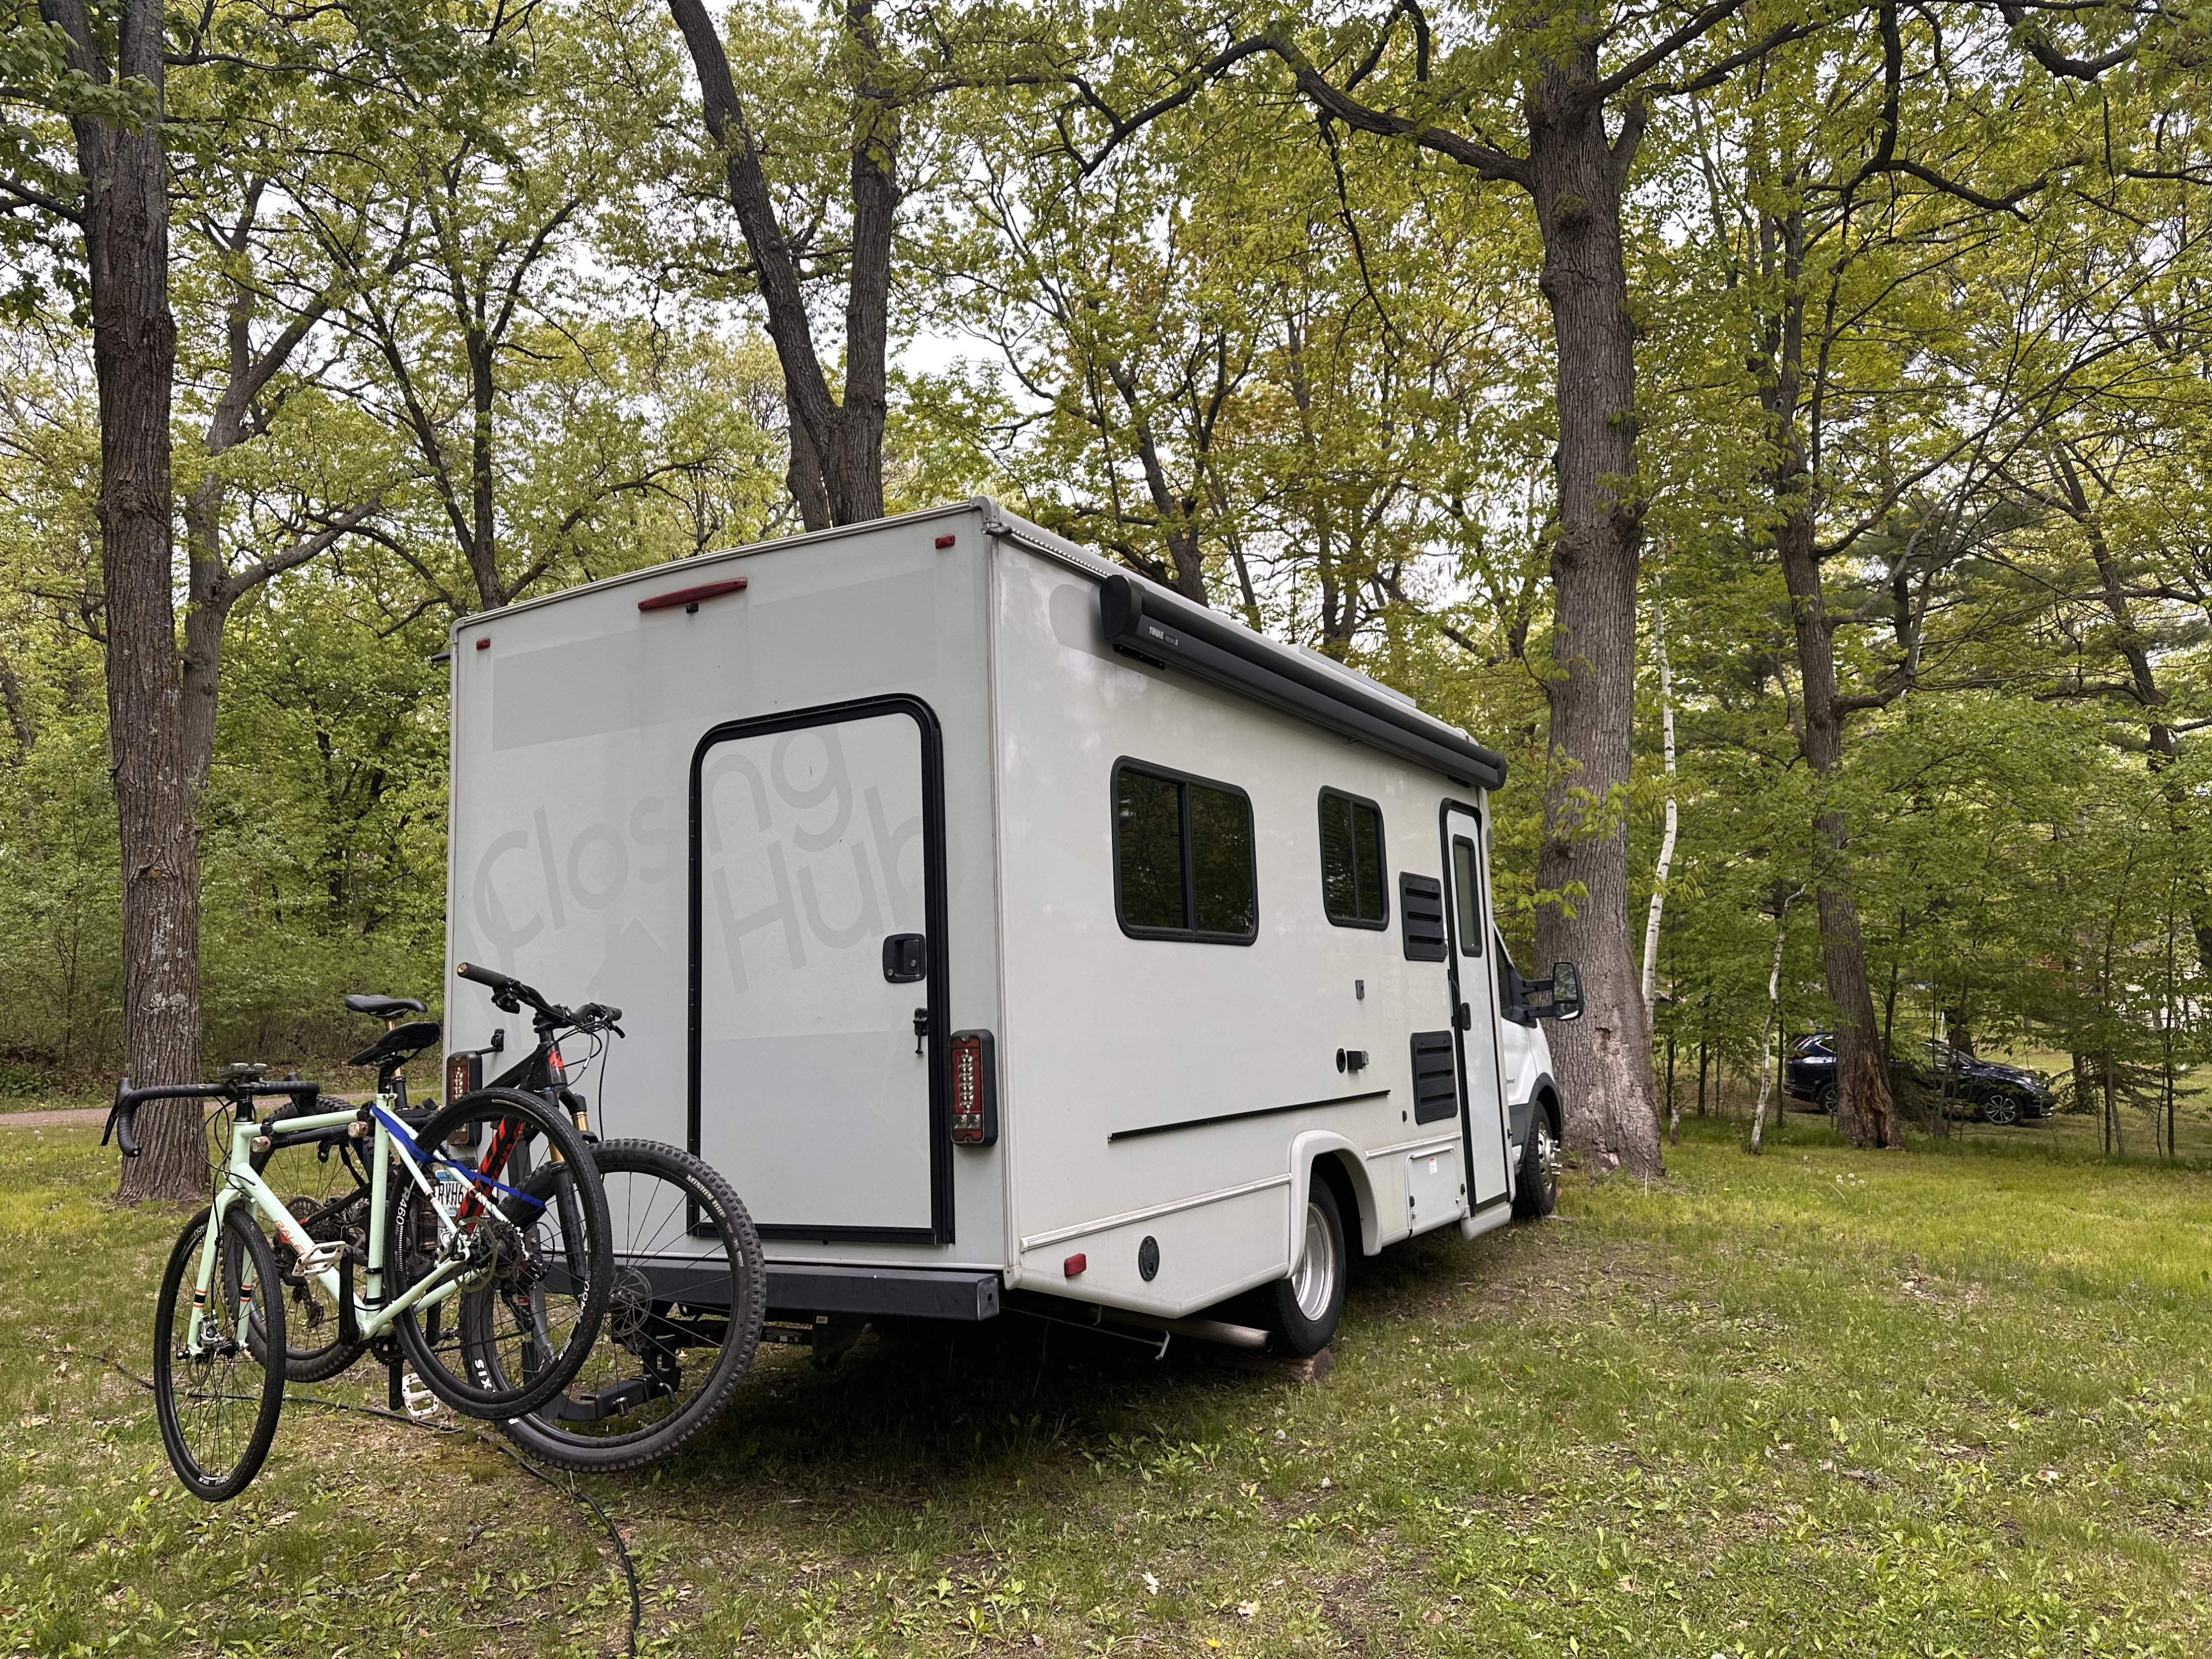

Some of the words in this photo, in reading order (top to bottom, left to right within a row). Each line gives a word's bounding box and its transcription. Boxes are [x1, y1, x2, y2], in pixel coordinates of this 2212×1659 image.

[1149, 626, 1164, 640] THULE
[686, 1174, 714, 1201] MINION
[396, 1186, 411, 1225] R460
